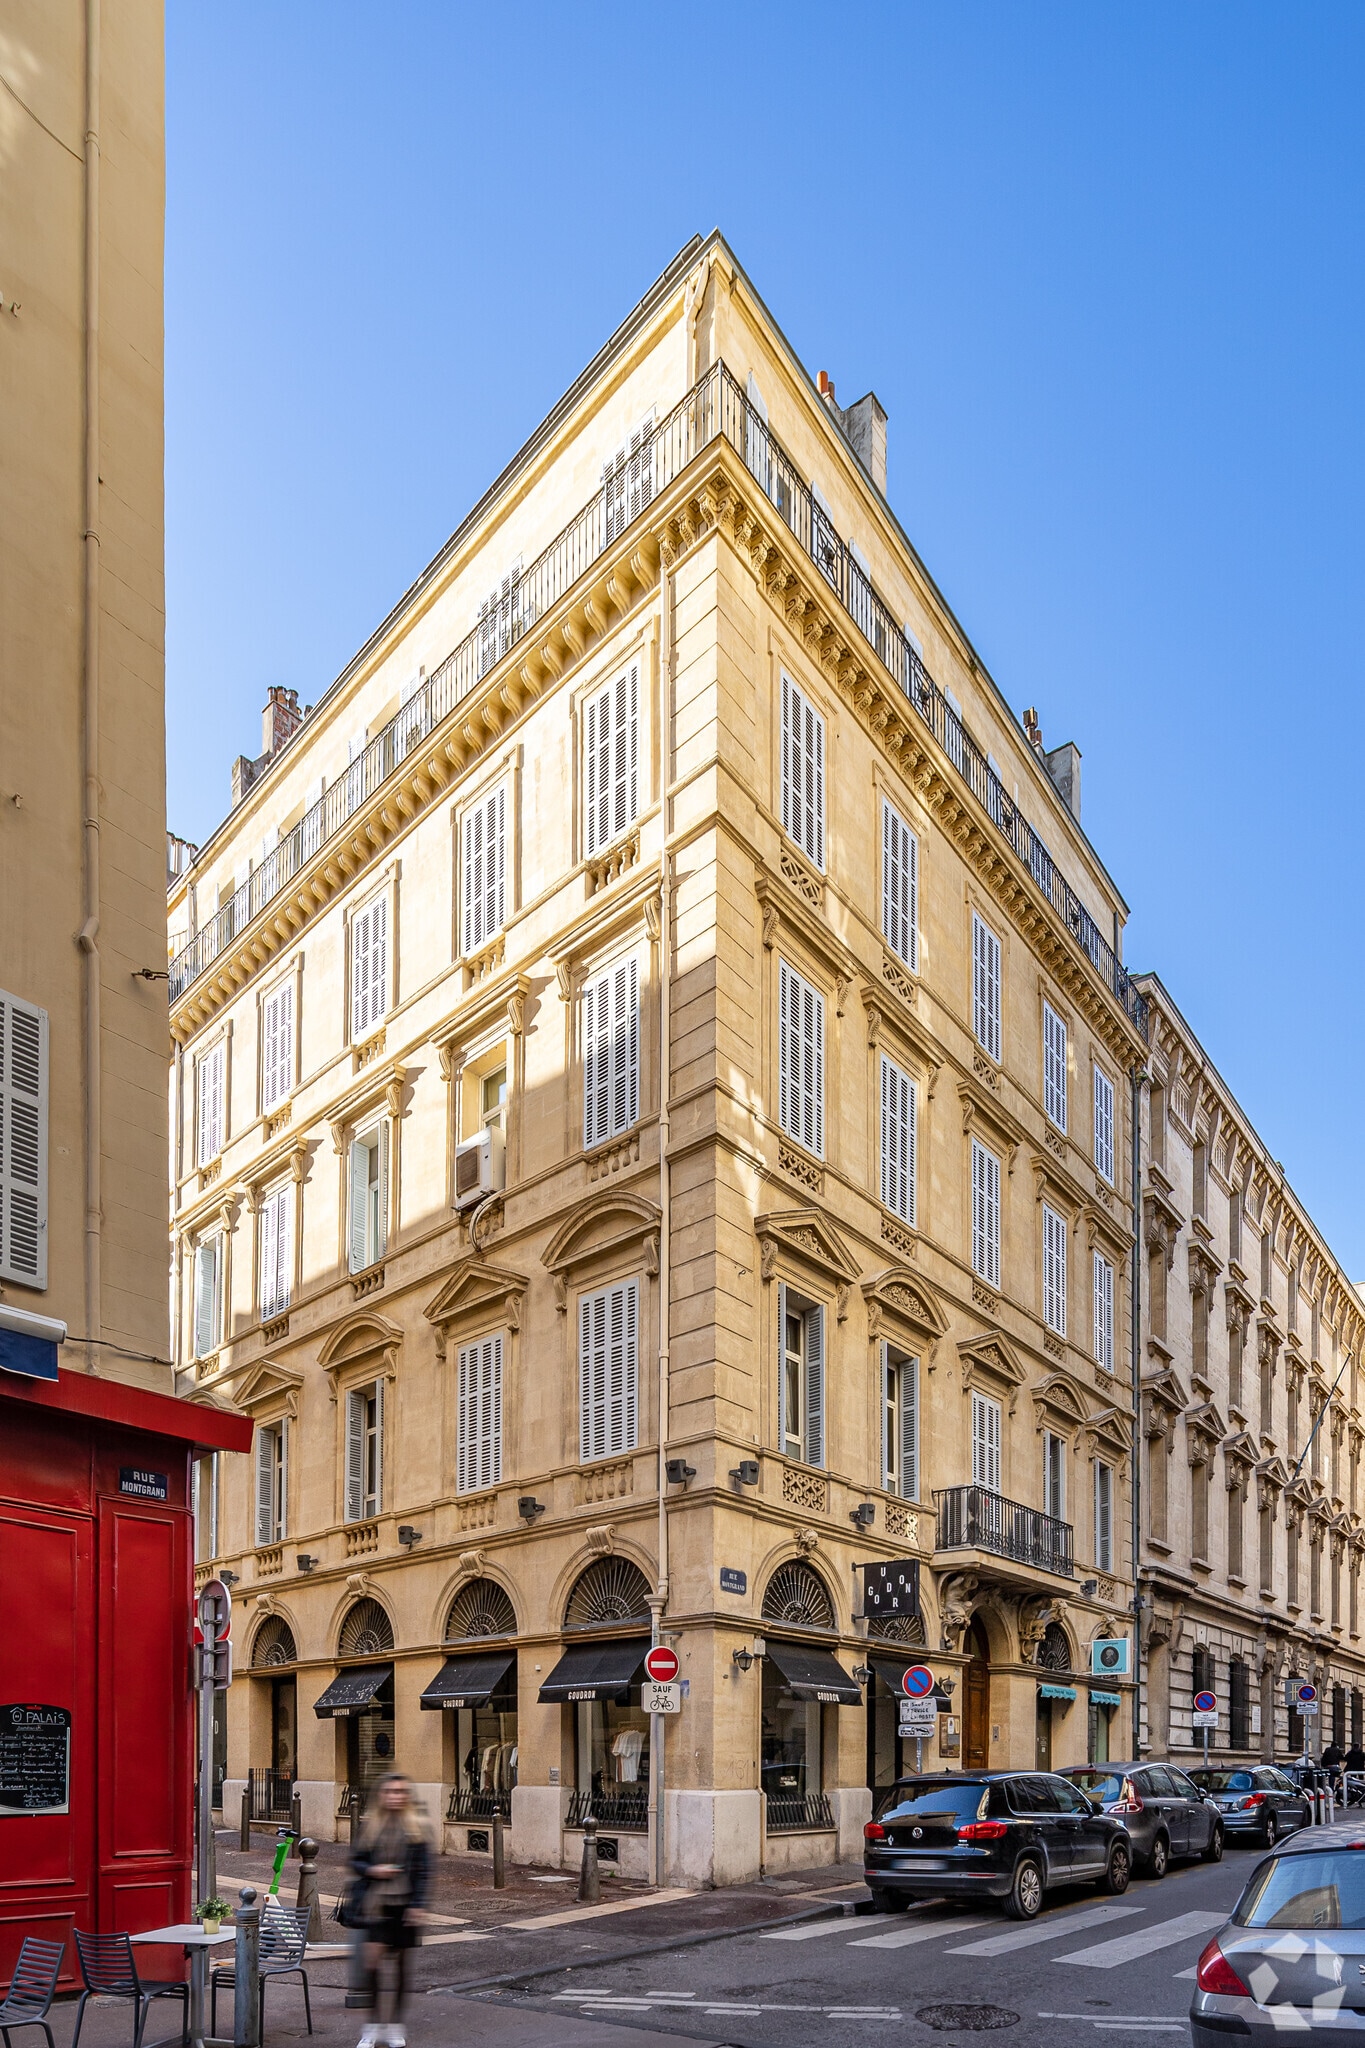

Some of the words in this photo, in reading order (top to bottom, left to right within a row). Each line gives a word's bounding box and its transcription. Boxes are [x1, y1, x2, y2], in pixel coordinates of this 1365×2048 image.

[133, 1471, 156, 1484] RUE
[121, 1481, 166, 1498] MONTGRAND
[652, 1685, 673, 1693] SAUF
[567, 1690, 597, 1701] GOUDRON
[816, 1691, 840, 1702] GOUDRON
